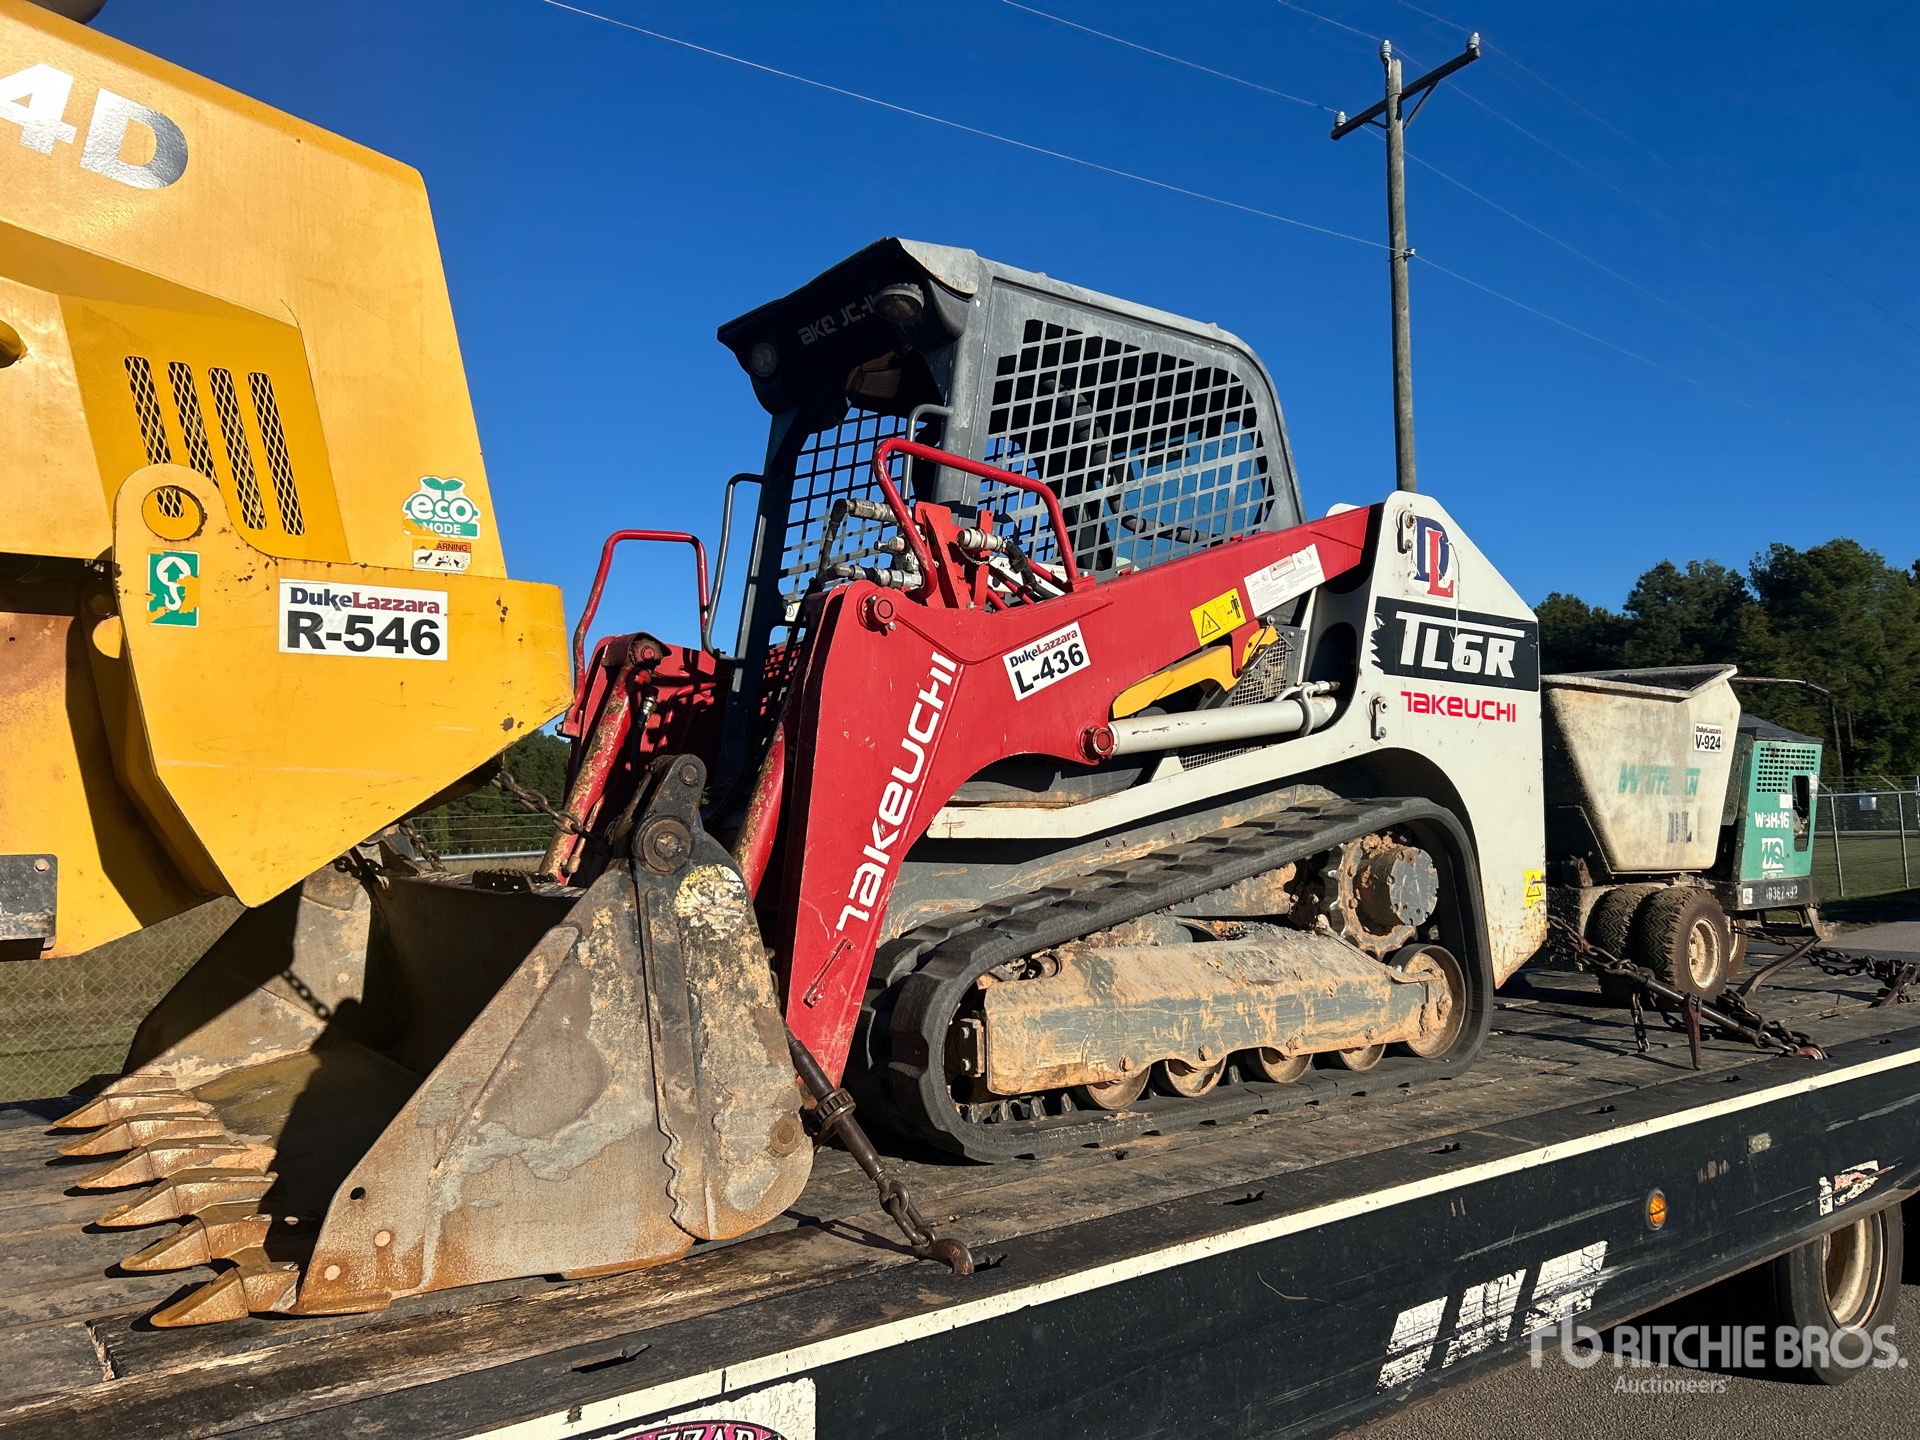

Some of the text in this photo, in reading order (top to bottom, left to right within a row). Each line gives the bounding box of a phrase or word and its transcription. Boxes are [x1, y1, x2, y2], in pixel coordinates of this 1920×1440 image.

[0, 63, 188, 190] 4D
[411, 494, 474, 523] eco
[436, 542, 468, 552] ARNING
[1414, 516, 1454, 598] DL
[289, 587, 440, 614] DukeLazzara
[287, 610, 440, 656] R-546
[1009, 629, 1078, 667] DukeLazzara
[1395, 610, 1525, 679] TL6R
[1015, 642, 1084, 694] L-436
[1400, 690, 1516, 723] TAKEUCHI
[1695, 734, 1721, 750] V-924
